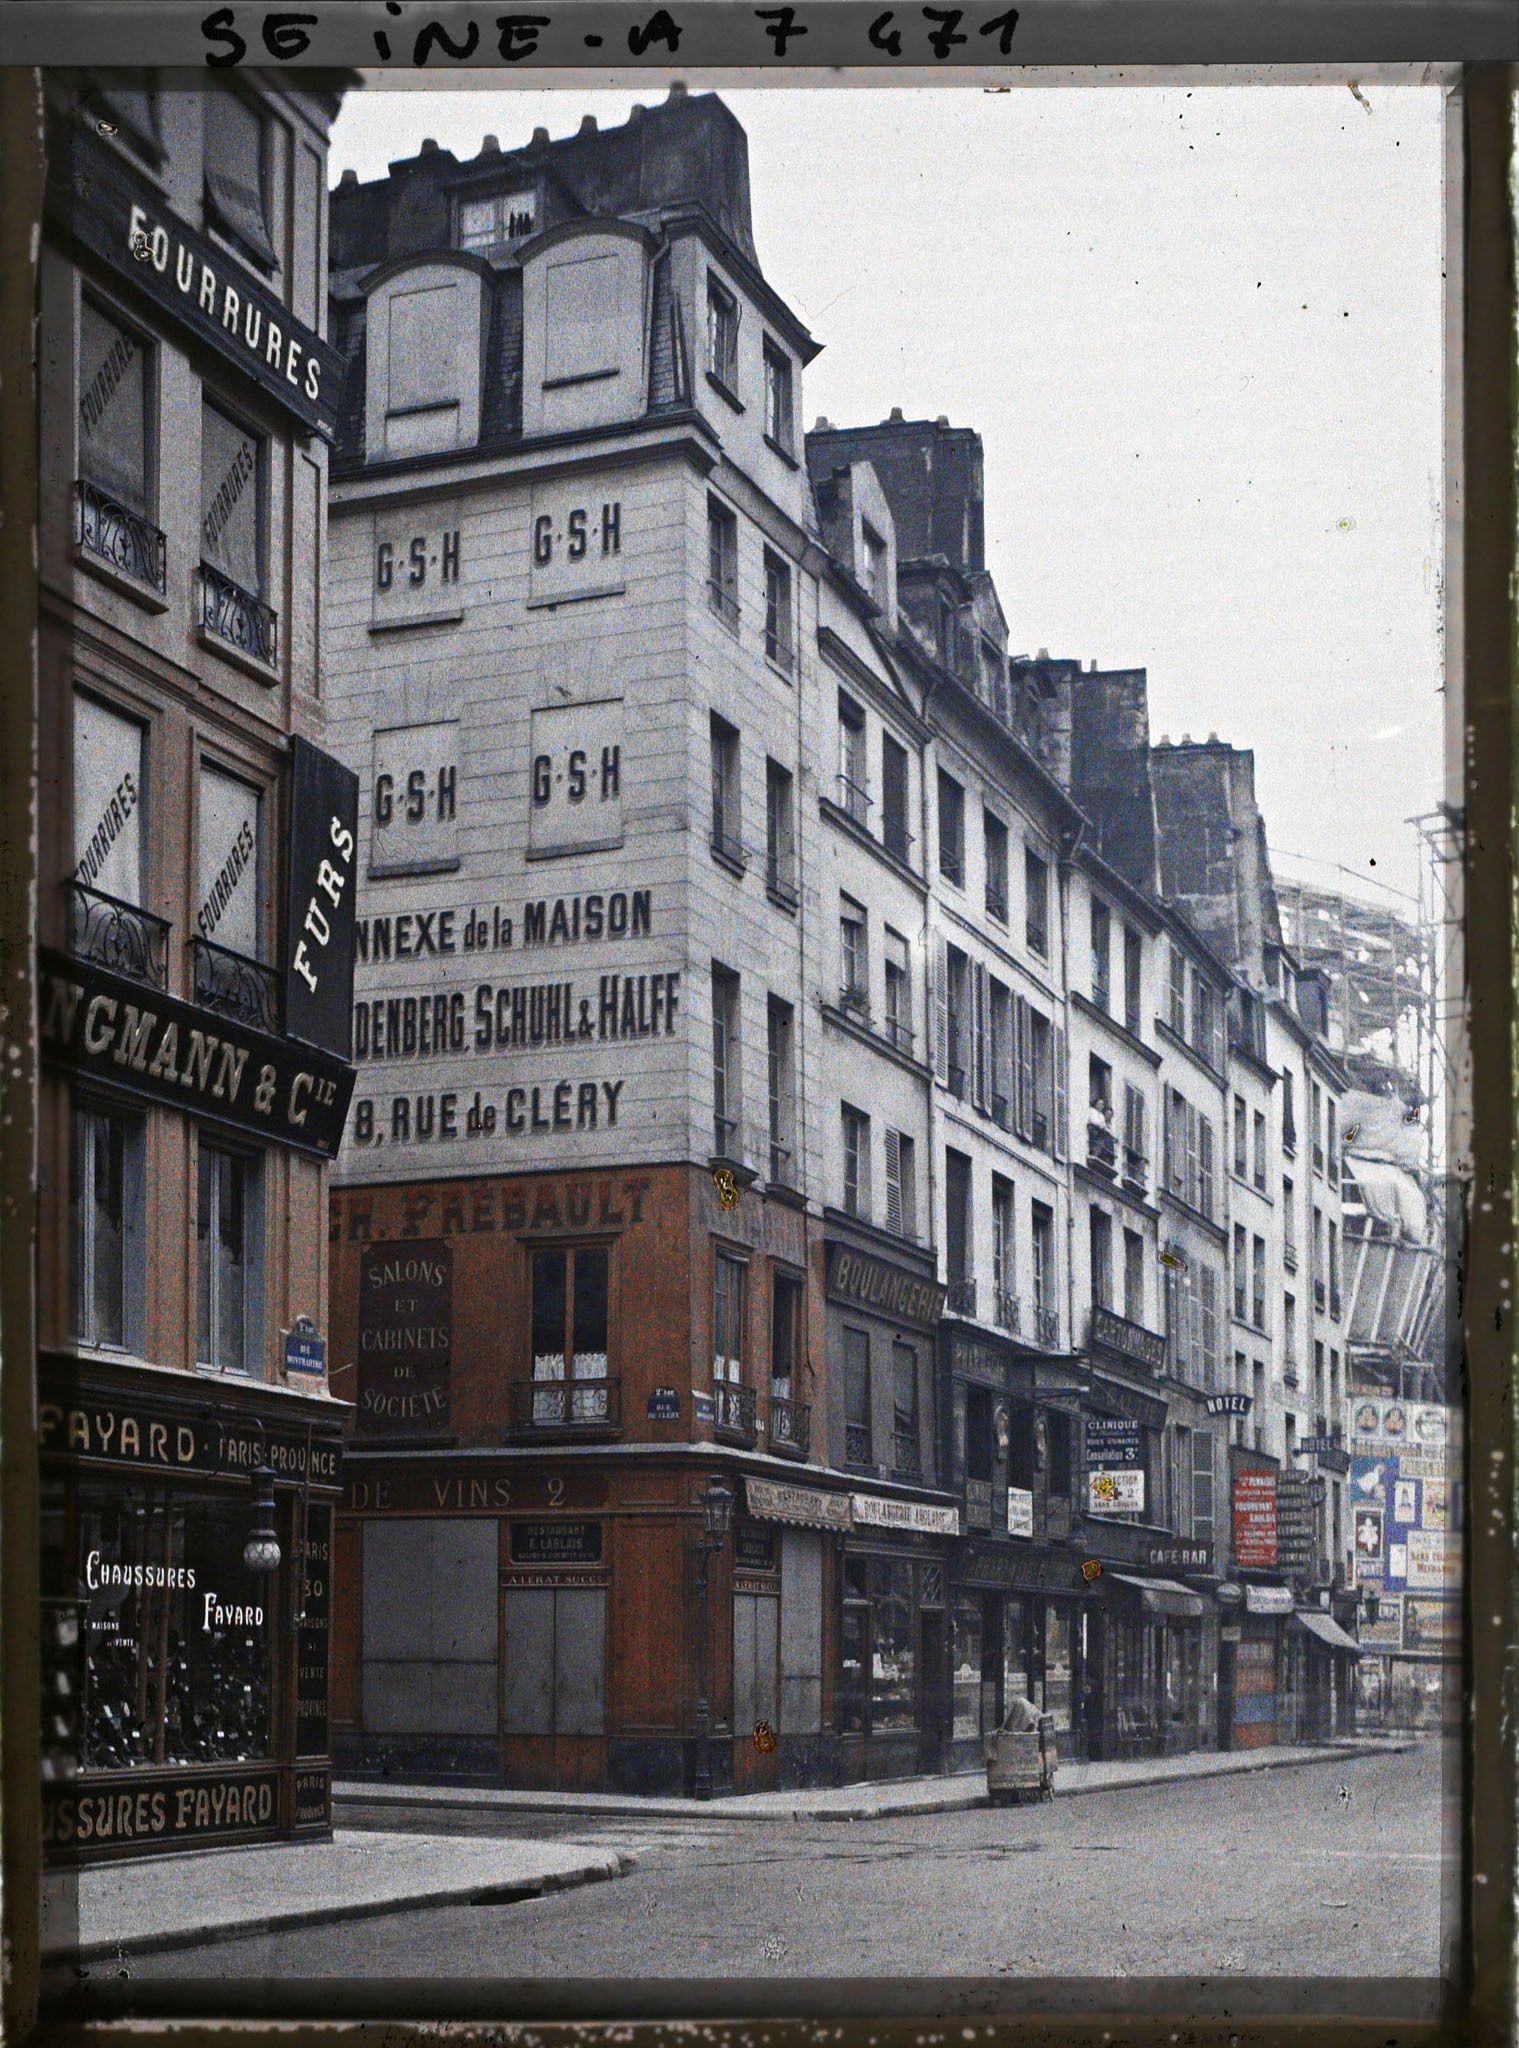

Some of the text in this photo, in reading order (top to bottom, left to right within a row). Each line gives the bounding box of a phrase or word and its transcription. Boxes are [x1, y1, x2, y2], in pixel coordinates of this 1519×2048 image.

[755, 9, 807, 56] 7
[129, 204, 322, 401] FOURRURES
[203, 441, 255, 547] FOURRURES
[199, 820, 255, 935] FOURRURES
[293, 816, 354, 993] FURS
[524, 889, 652, 944] MAISON
[578, 1000, 595, 1037] &
[600, 972, 681, 1038] HALFF
[254, 1065, 276, 1115] &
[391, 1093, 458, 1140] RUE
[466, 1092, 496, 1134] de
[506, 1079, 626, 1131] CLÉRY
[368, 1260, 448, 1288] SALONS
[838, 1253, 944, 1325] BOULANGERIE
[395, 1298, 419, 1313] ET
[362, 1327, 449, 1351] CABINETS
[394, 1366, 415, 1379] DE
[1087, 1420, 1139, 1430] CLINIQUE
[1207, 1397, 1246, 1414] HOTEL
[39, 1403, 195, 1463] FAYARD
[270, 1445, 337, 1475] PROVNCE
[352, 1477, 565, 1510] DE VINS 2
[86, 1550, 197, 1590] CHAUSSURES
[1183, 1550, 1207, 1564] BAR
[303, 1579, 323, 1597] 30
[91, 1621, 120, 1632] MAISONS
[202, 1592, 264, 1633] FAYARD
[115, 1638, 134, 1647] VENTE
[299, 1665, 325, 1679] VENTE
[297, 1775, 325, 1792] PARIS
[175, 1783, 272, 1830] FAYARD
